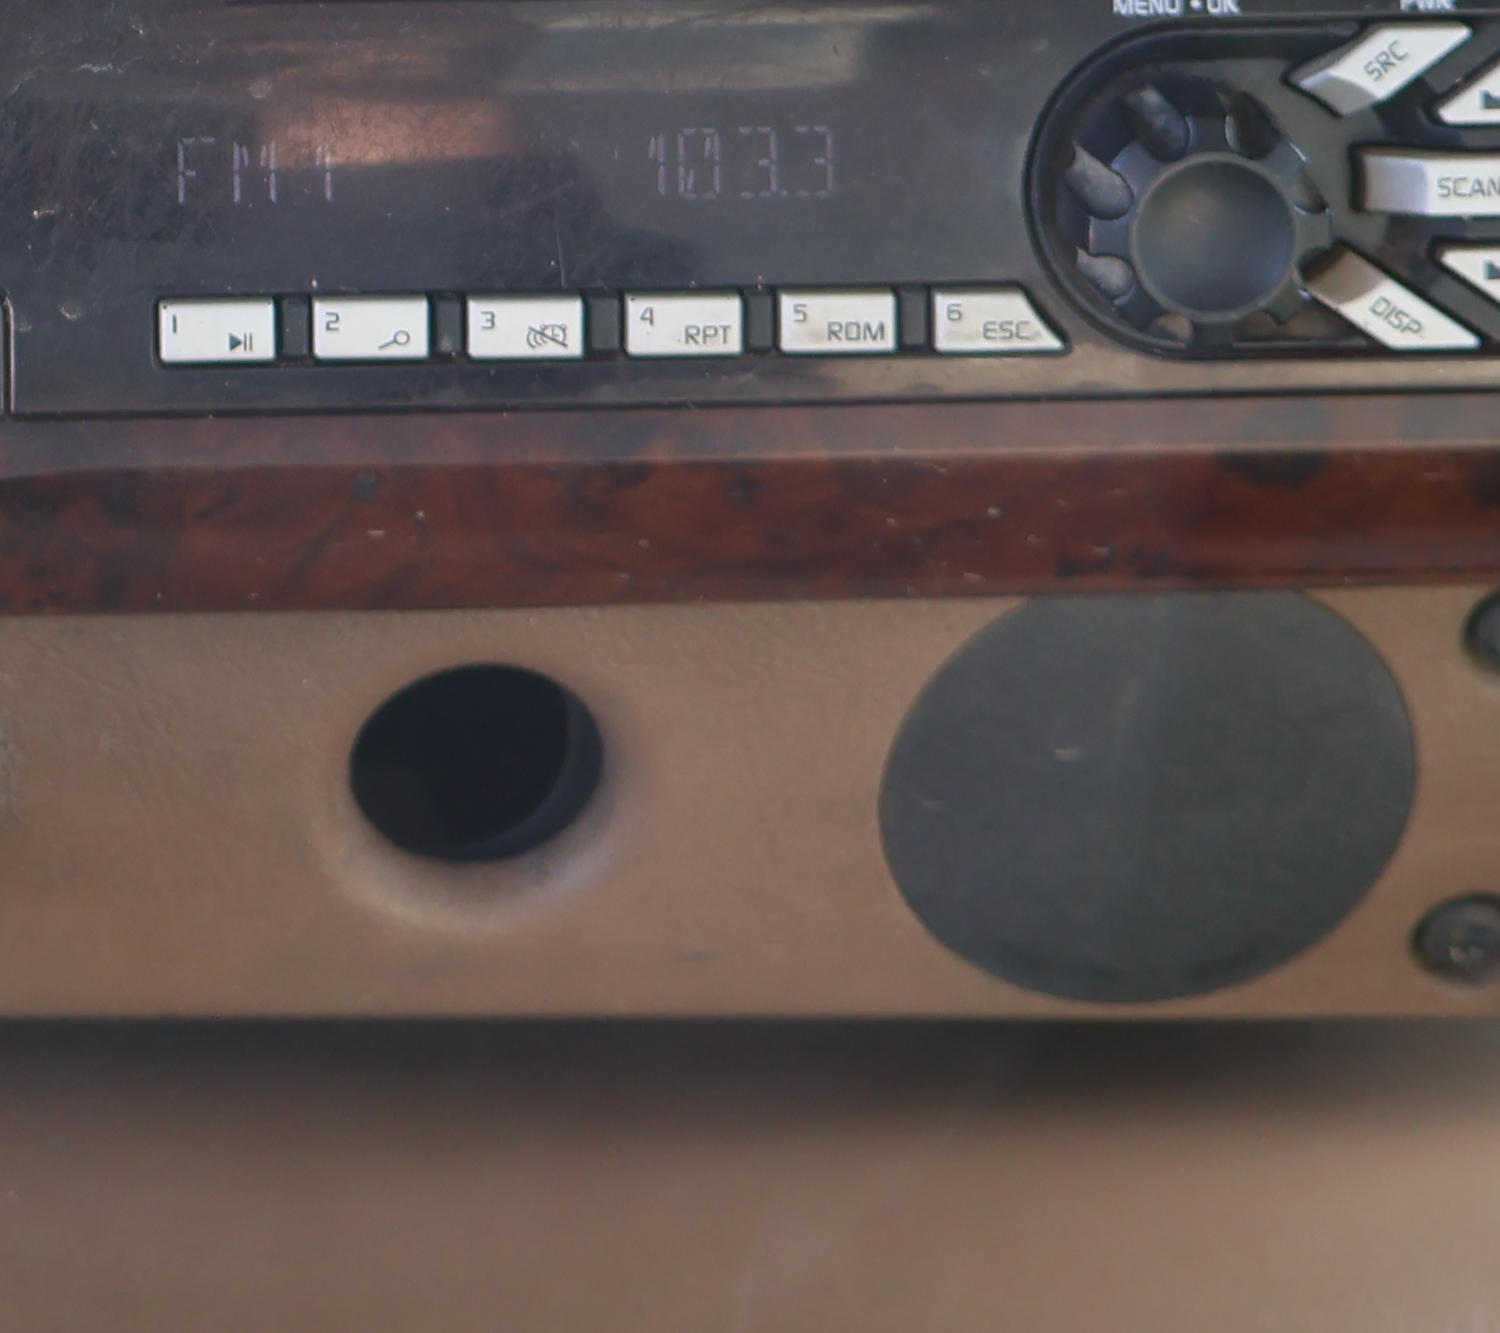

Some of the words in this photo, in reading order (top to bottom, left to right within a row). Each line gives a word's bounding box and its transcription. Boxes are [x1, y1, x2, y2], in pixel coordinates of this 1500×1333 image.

[1364, 39, 1410, 82] SRC
[169, 313, 178, 334] 1
[324, 311, 341, 332] 2
[481, 309, 496, 330] 3
[639, 305, 655, 326] 4
[792, 302, 807, 324] 5
[947, 303, 962, 323] 6
[1370, 294, 1423, 337] DISP
[683, 323, 733, 347] RPT
[826, 320, 886, 343] RDM
[982, 318, 1031, 342] ESC
